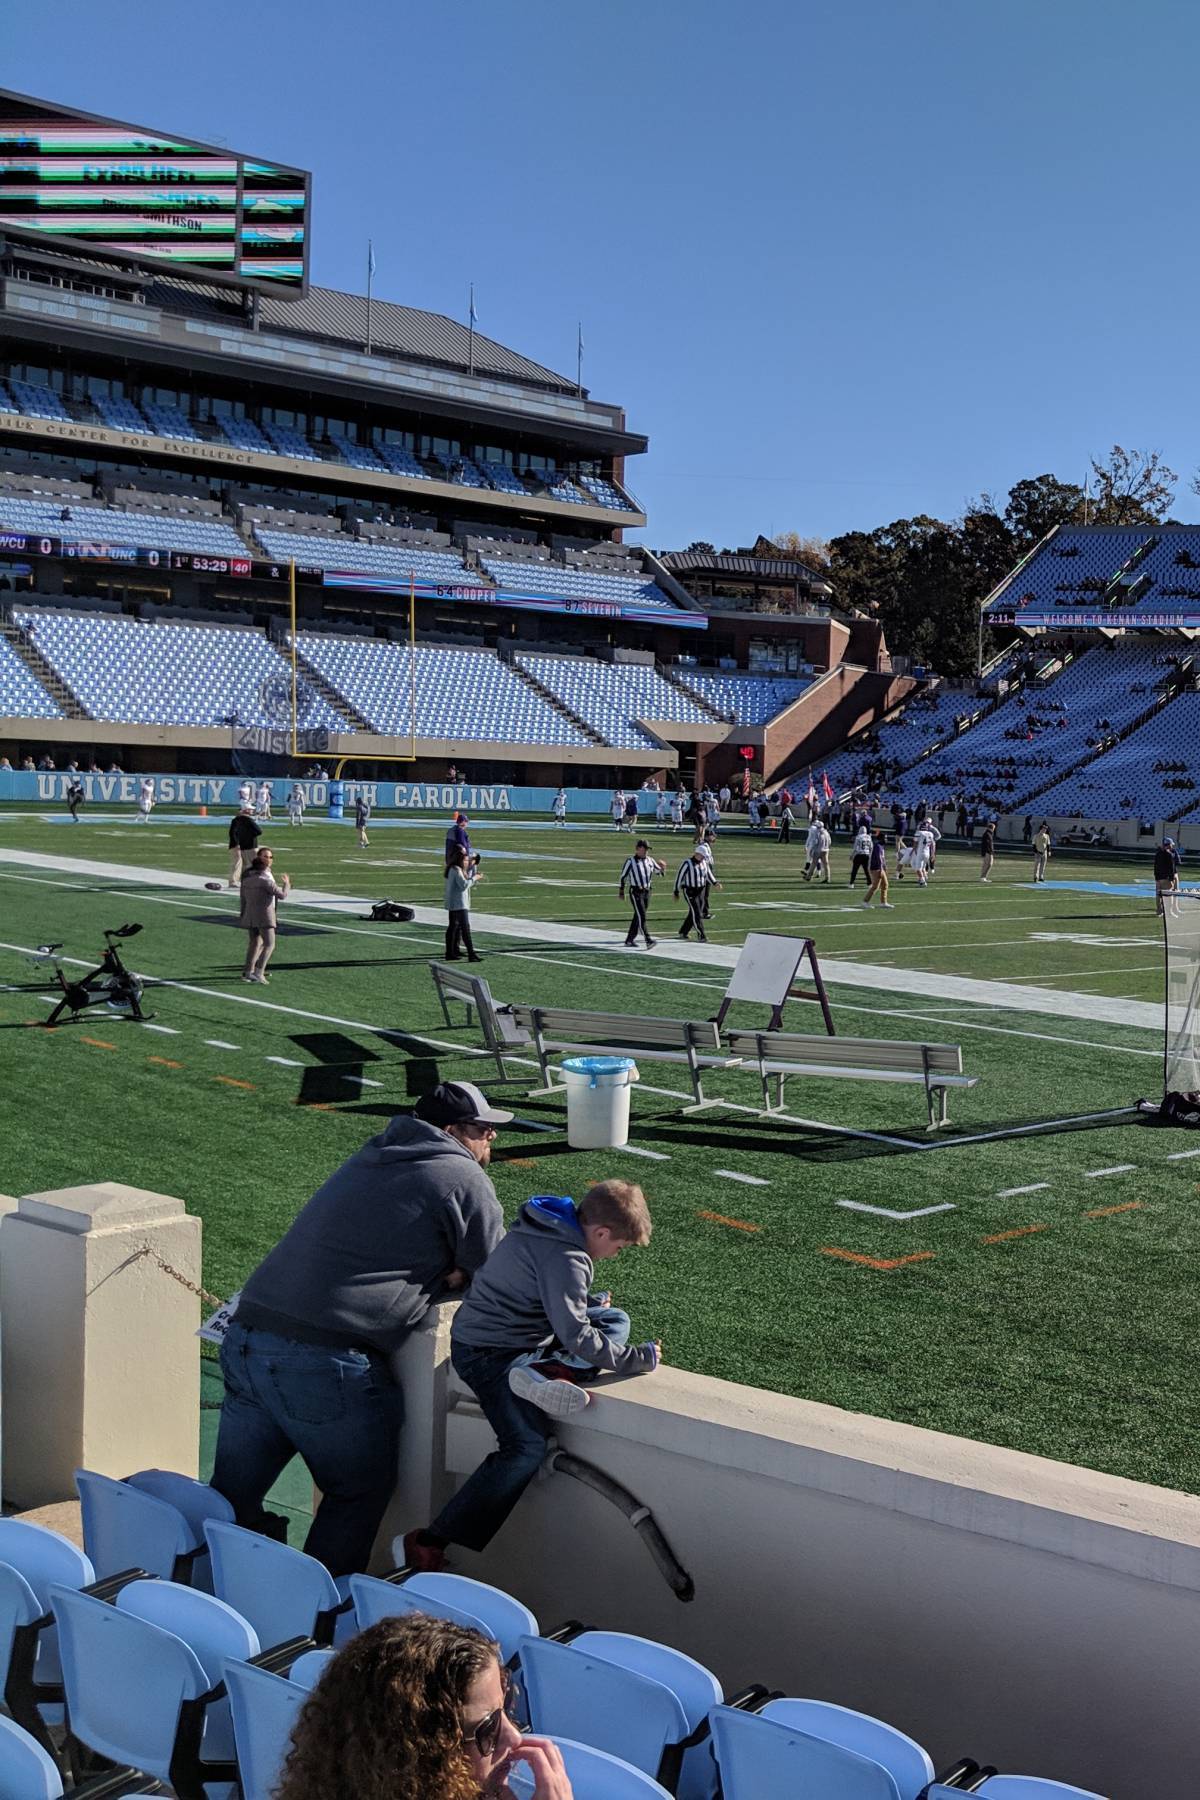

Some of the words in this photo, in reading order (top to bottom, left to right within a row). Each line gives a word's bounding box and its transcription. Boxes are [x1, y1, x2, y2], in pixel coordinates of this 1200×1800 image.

[46, 424, 109, 442] CENTER
[122, 436, 150, 448] FOR
[164, 443, 254, 464] EXCELLENCE
[40, 538, 52, 554] 0
[111, 549, 137, 561] UNC
[148, 550, 160, 566] 0
[193, 557, 228, 572] 53:29
[234, 563, 249, 574] 40
[437, 584, 453, 598] 64
[455, 587, 496, 603] COOPER
[1043, 614, 1088, 625] WELCOME
[1092, 614, 1102, 625] TO
[1107, 614, 1137, 625] KENAN
[1141, 614, 1184, 625] STADIUM
[301, 782, 378, 807] NOTH
[394, 785, 511, 810] CAROLINA
